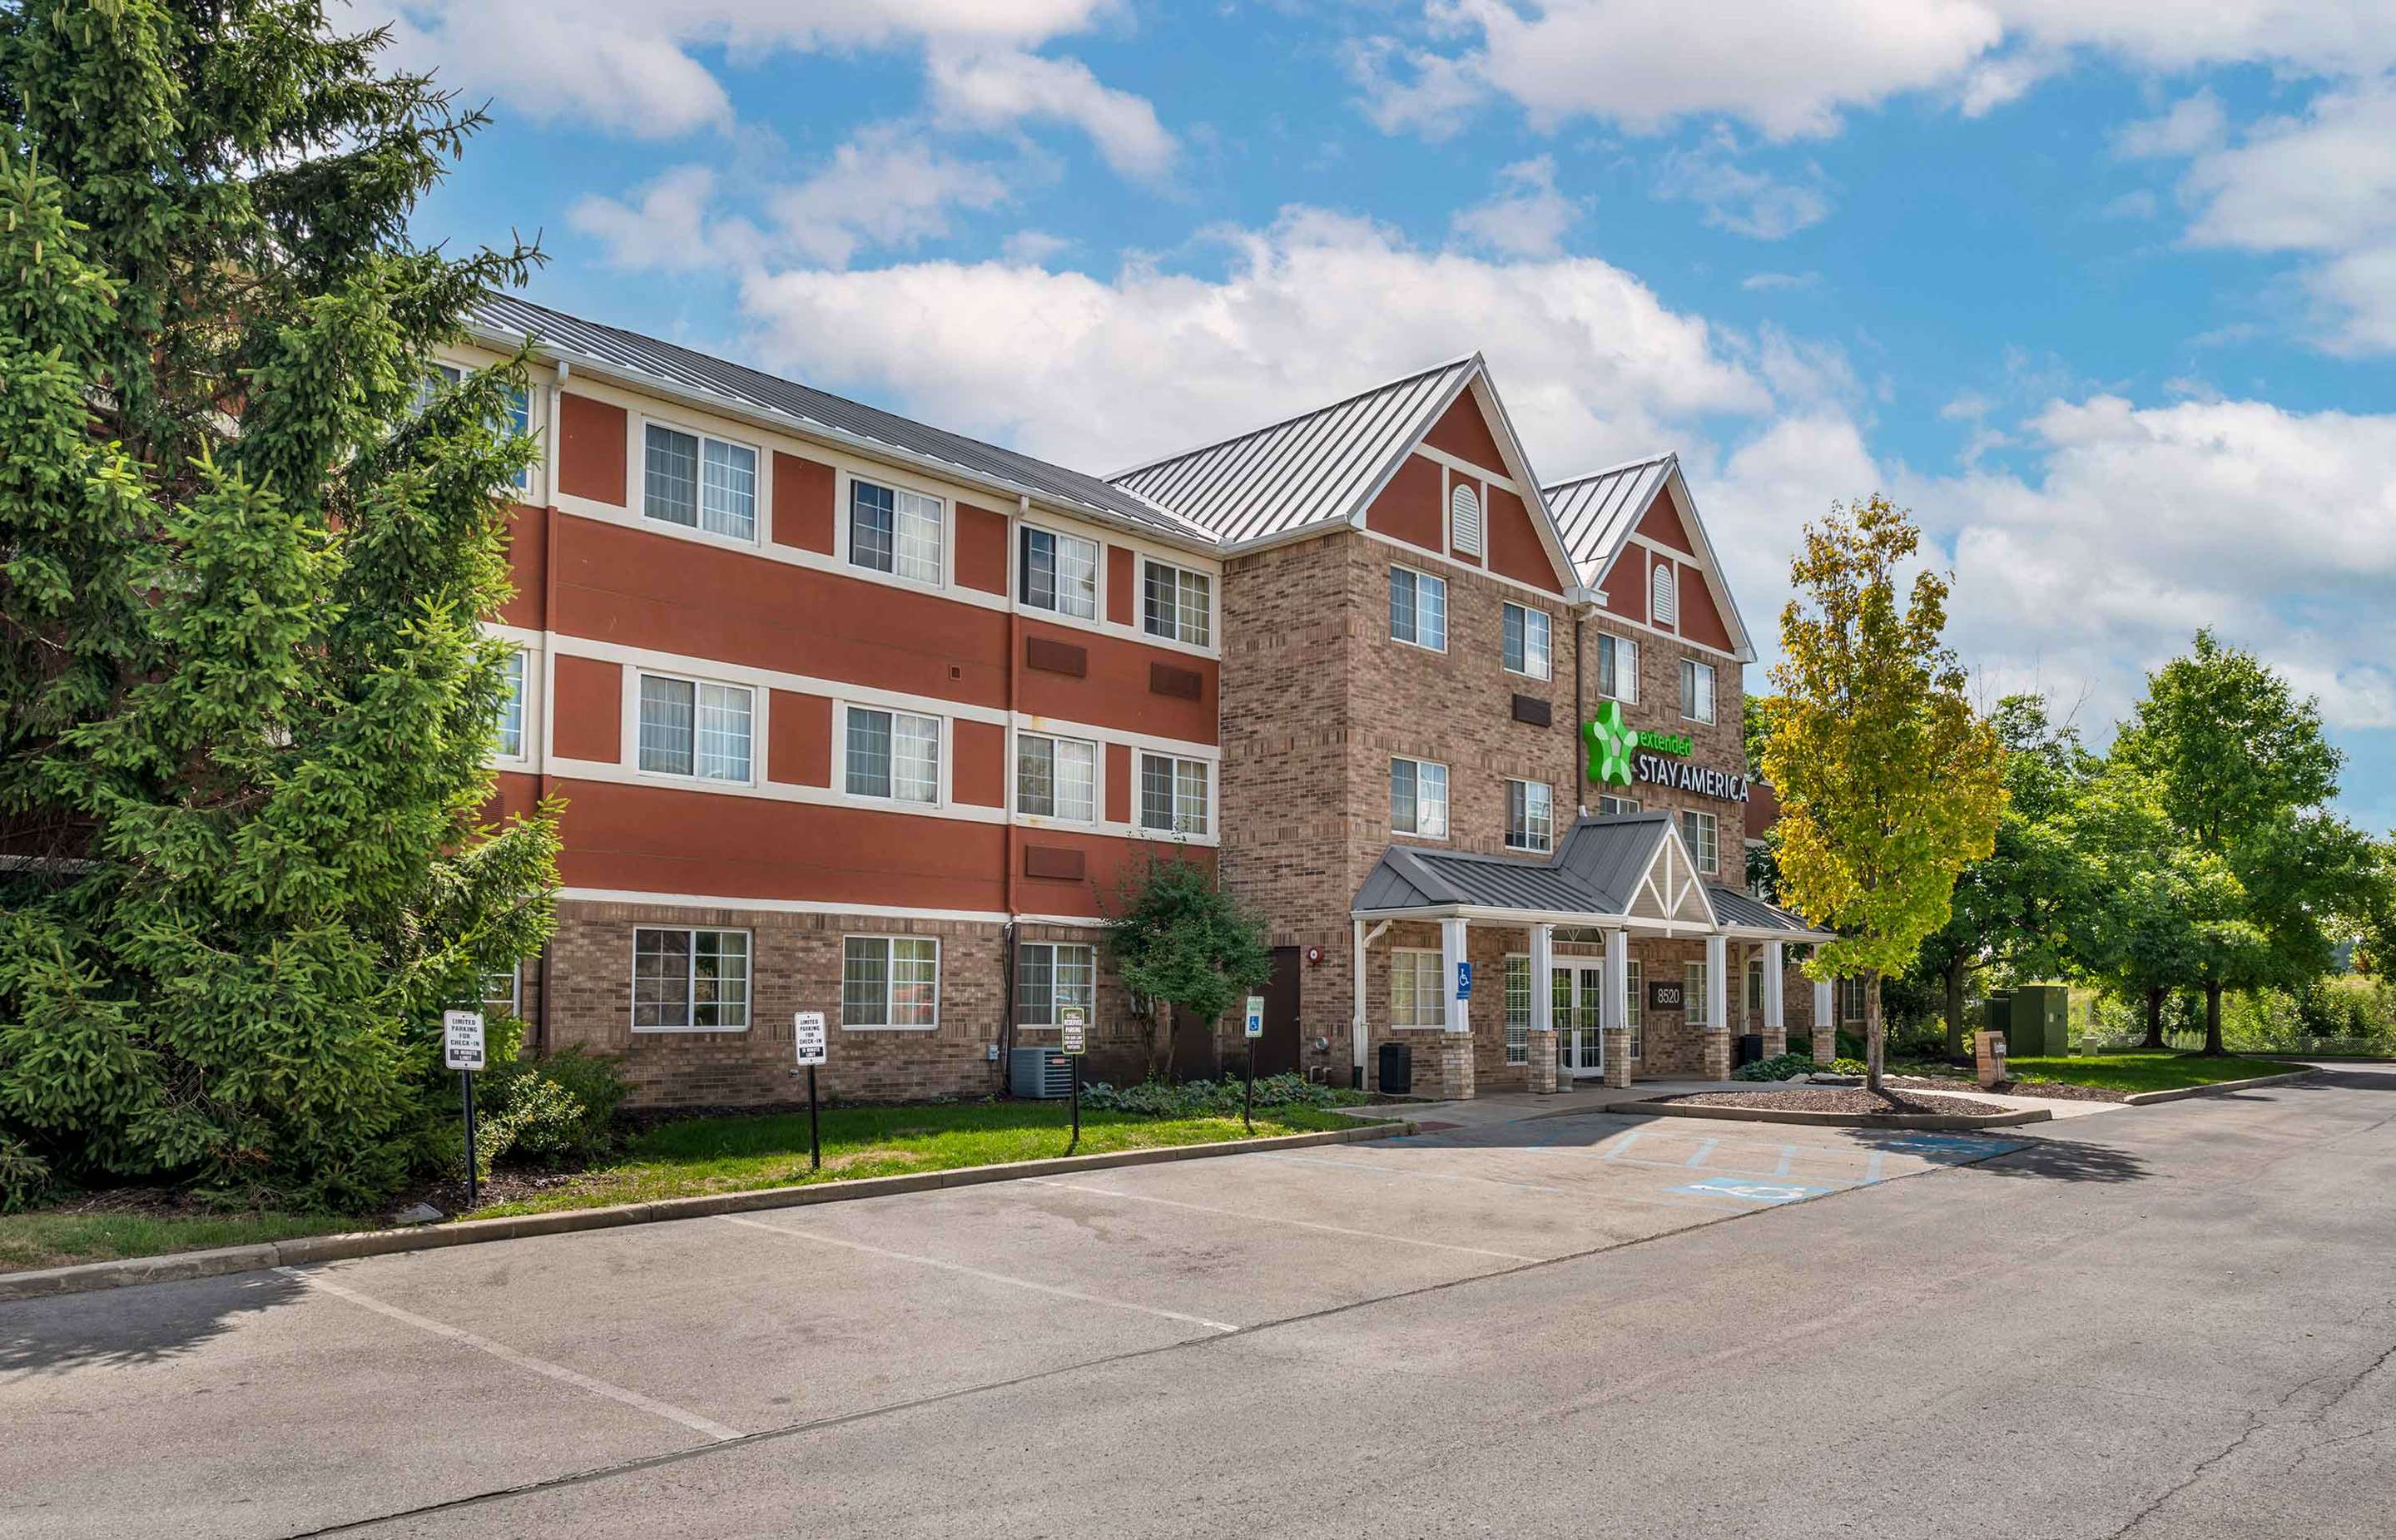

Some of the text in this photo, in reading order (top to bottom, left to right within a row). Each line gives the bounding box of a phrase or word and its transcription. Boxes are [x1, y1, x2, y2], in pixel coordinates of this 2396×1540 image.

[1640, 731, 1691, 756] extended
[1639, 754, 1749, 802] STAY AMERICA
[1658, 988, 1679, 1003] 8520
